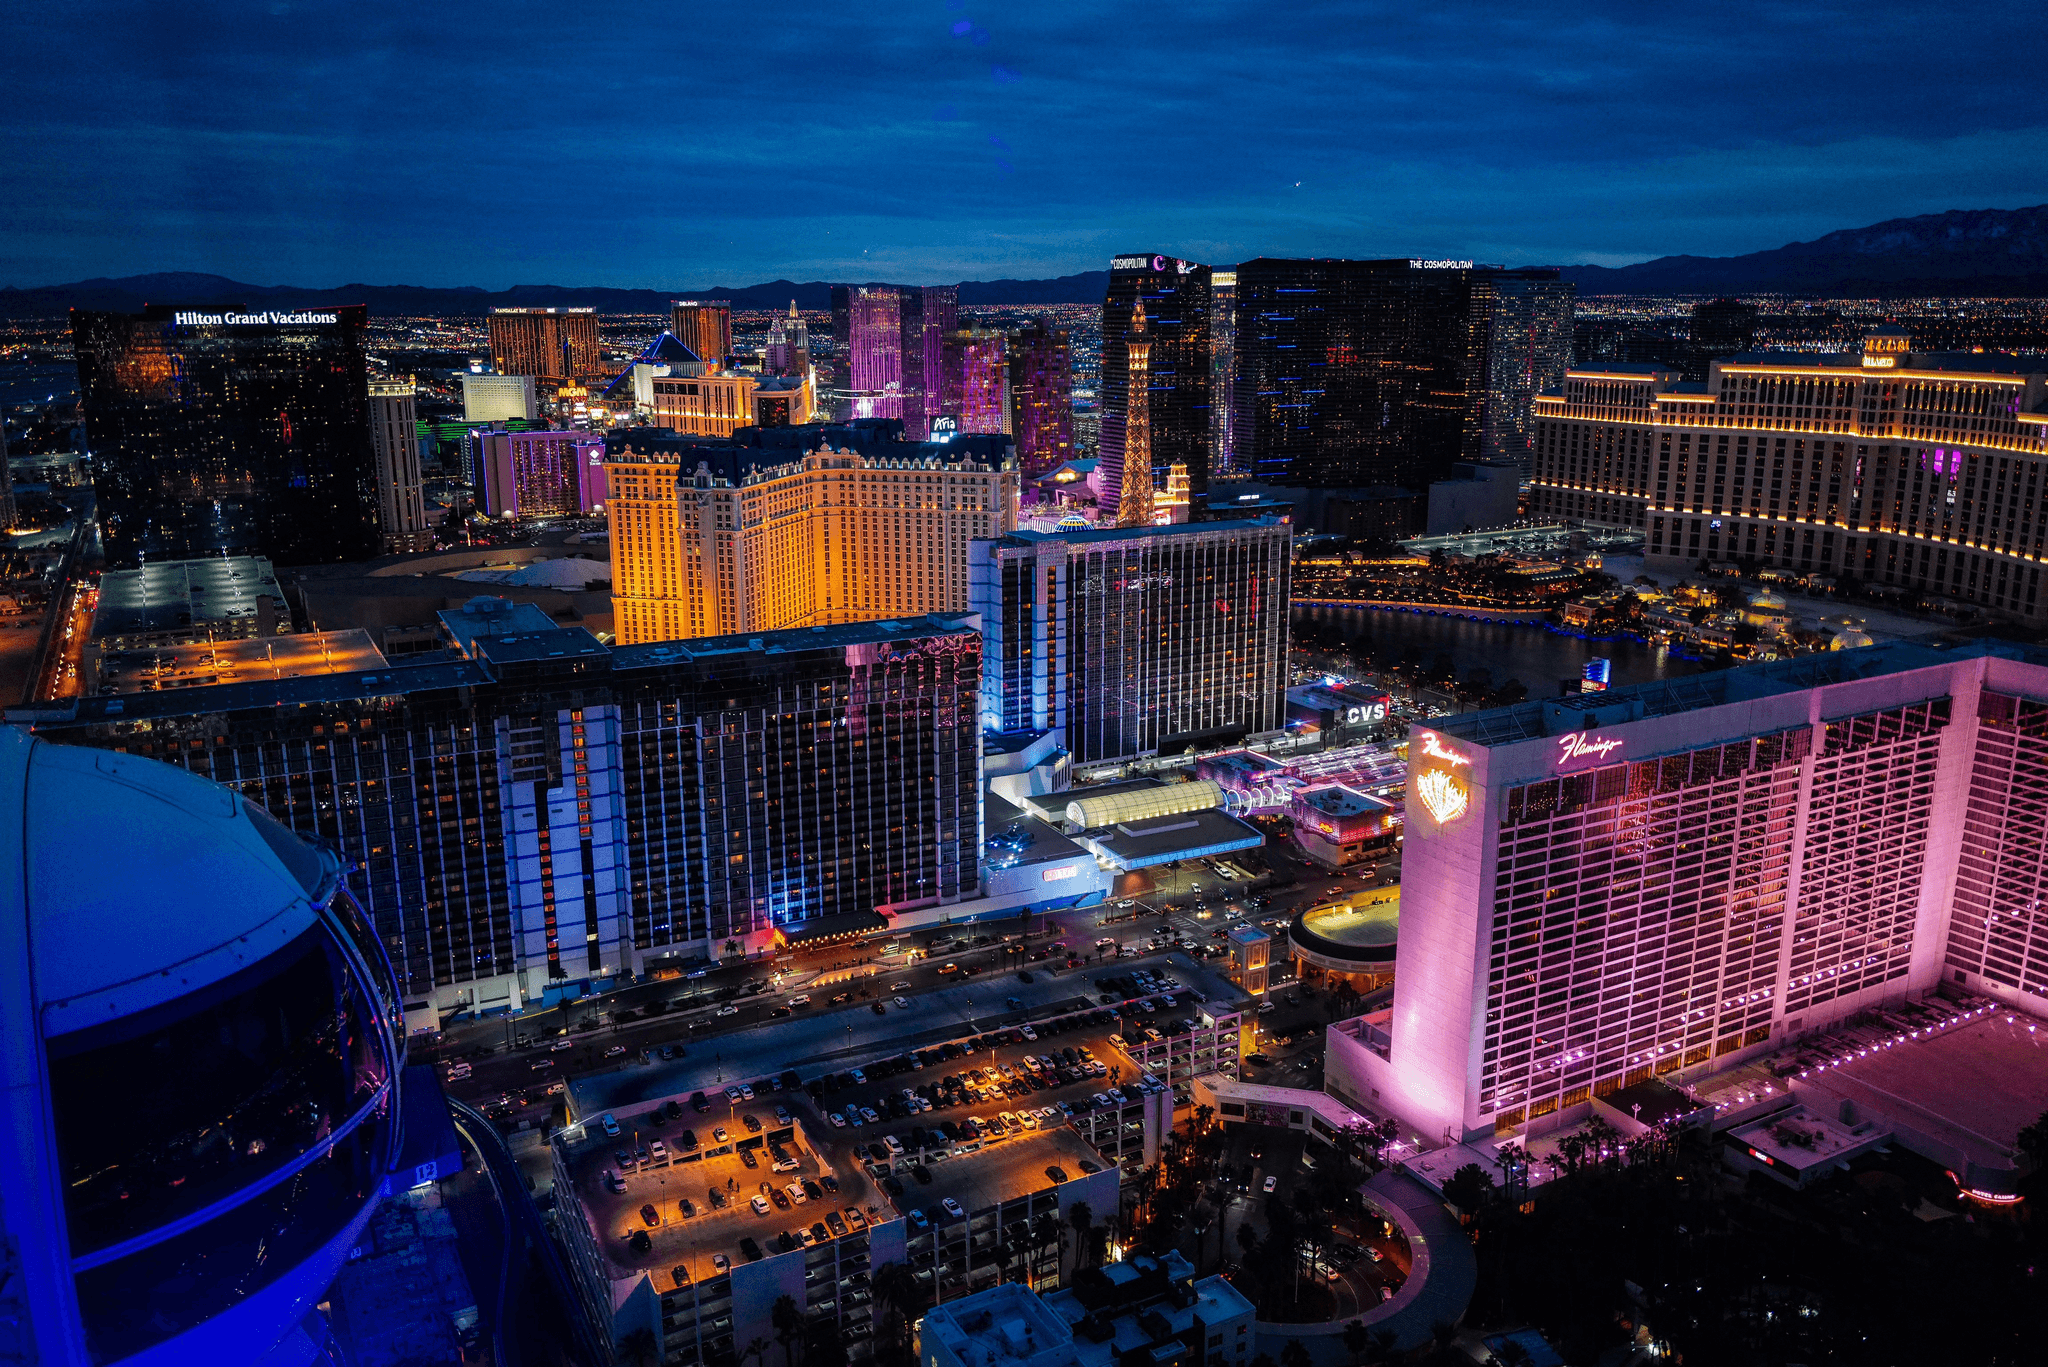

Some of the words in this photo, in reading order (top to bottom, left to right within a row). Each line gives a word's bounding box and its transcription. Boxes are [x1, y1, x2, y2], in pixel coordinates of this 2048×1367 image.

[1113, 257, 1147, 270] COSMOPOLITAN
[1153, 255, 1166, 271] C
[1409, 260, 1423, 269] THE
[1423, 260, 1473, 269] COSMOPOLITAN
[175, 311, 223, 325] Hilton
[224, 311, 268, 325] Grand
[269, 311, 337, 325] Vacations
[558, 386, 588, 398] MGM
[933, 416, 956, 431] Aria
[1347, 703, 1385, 724] CVS
[1558, 731, 1623, 765] Flamingo
